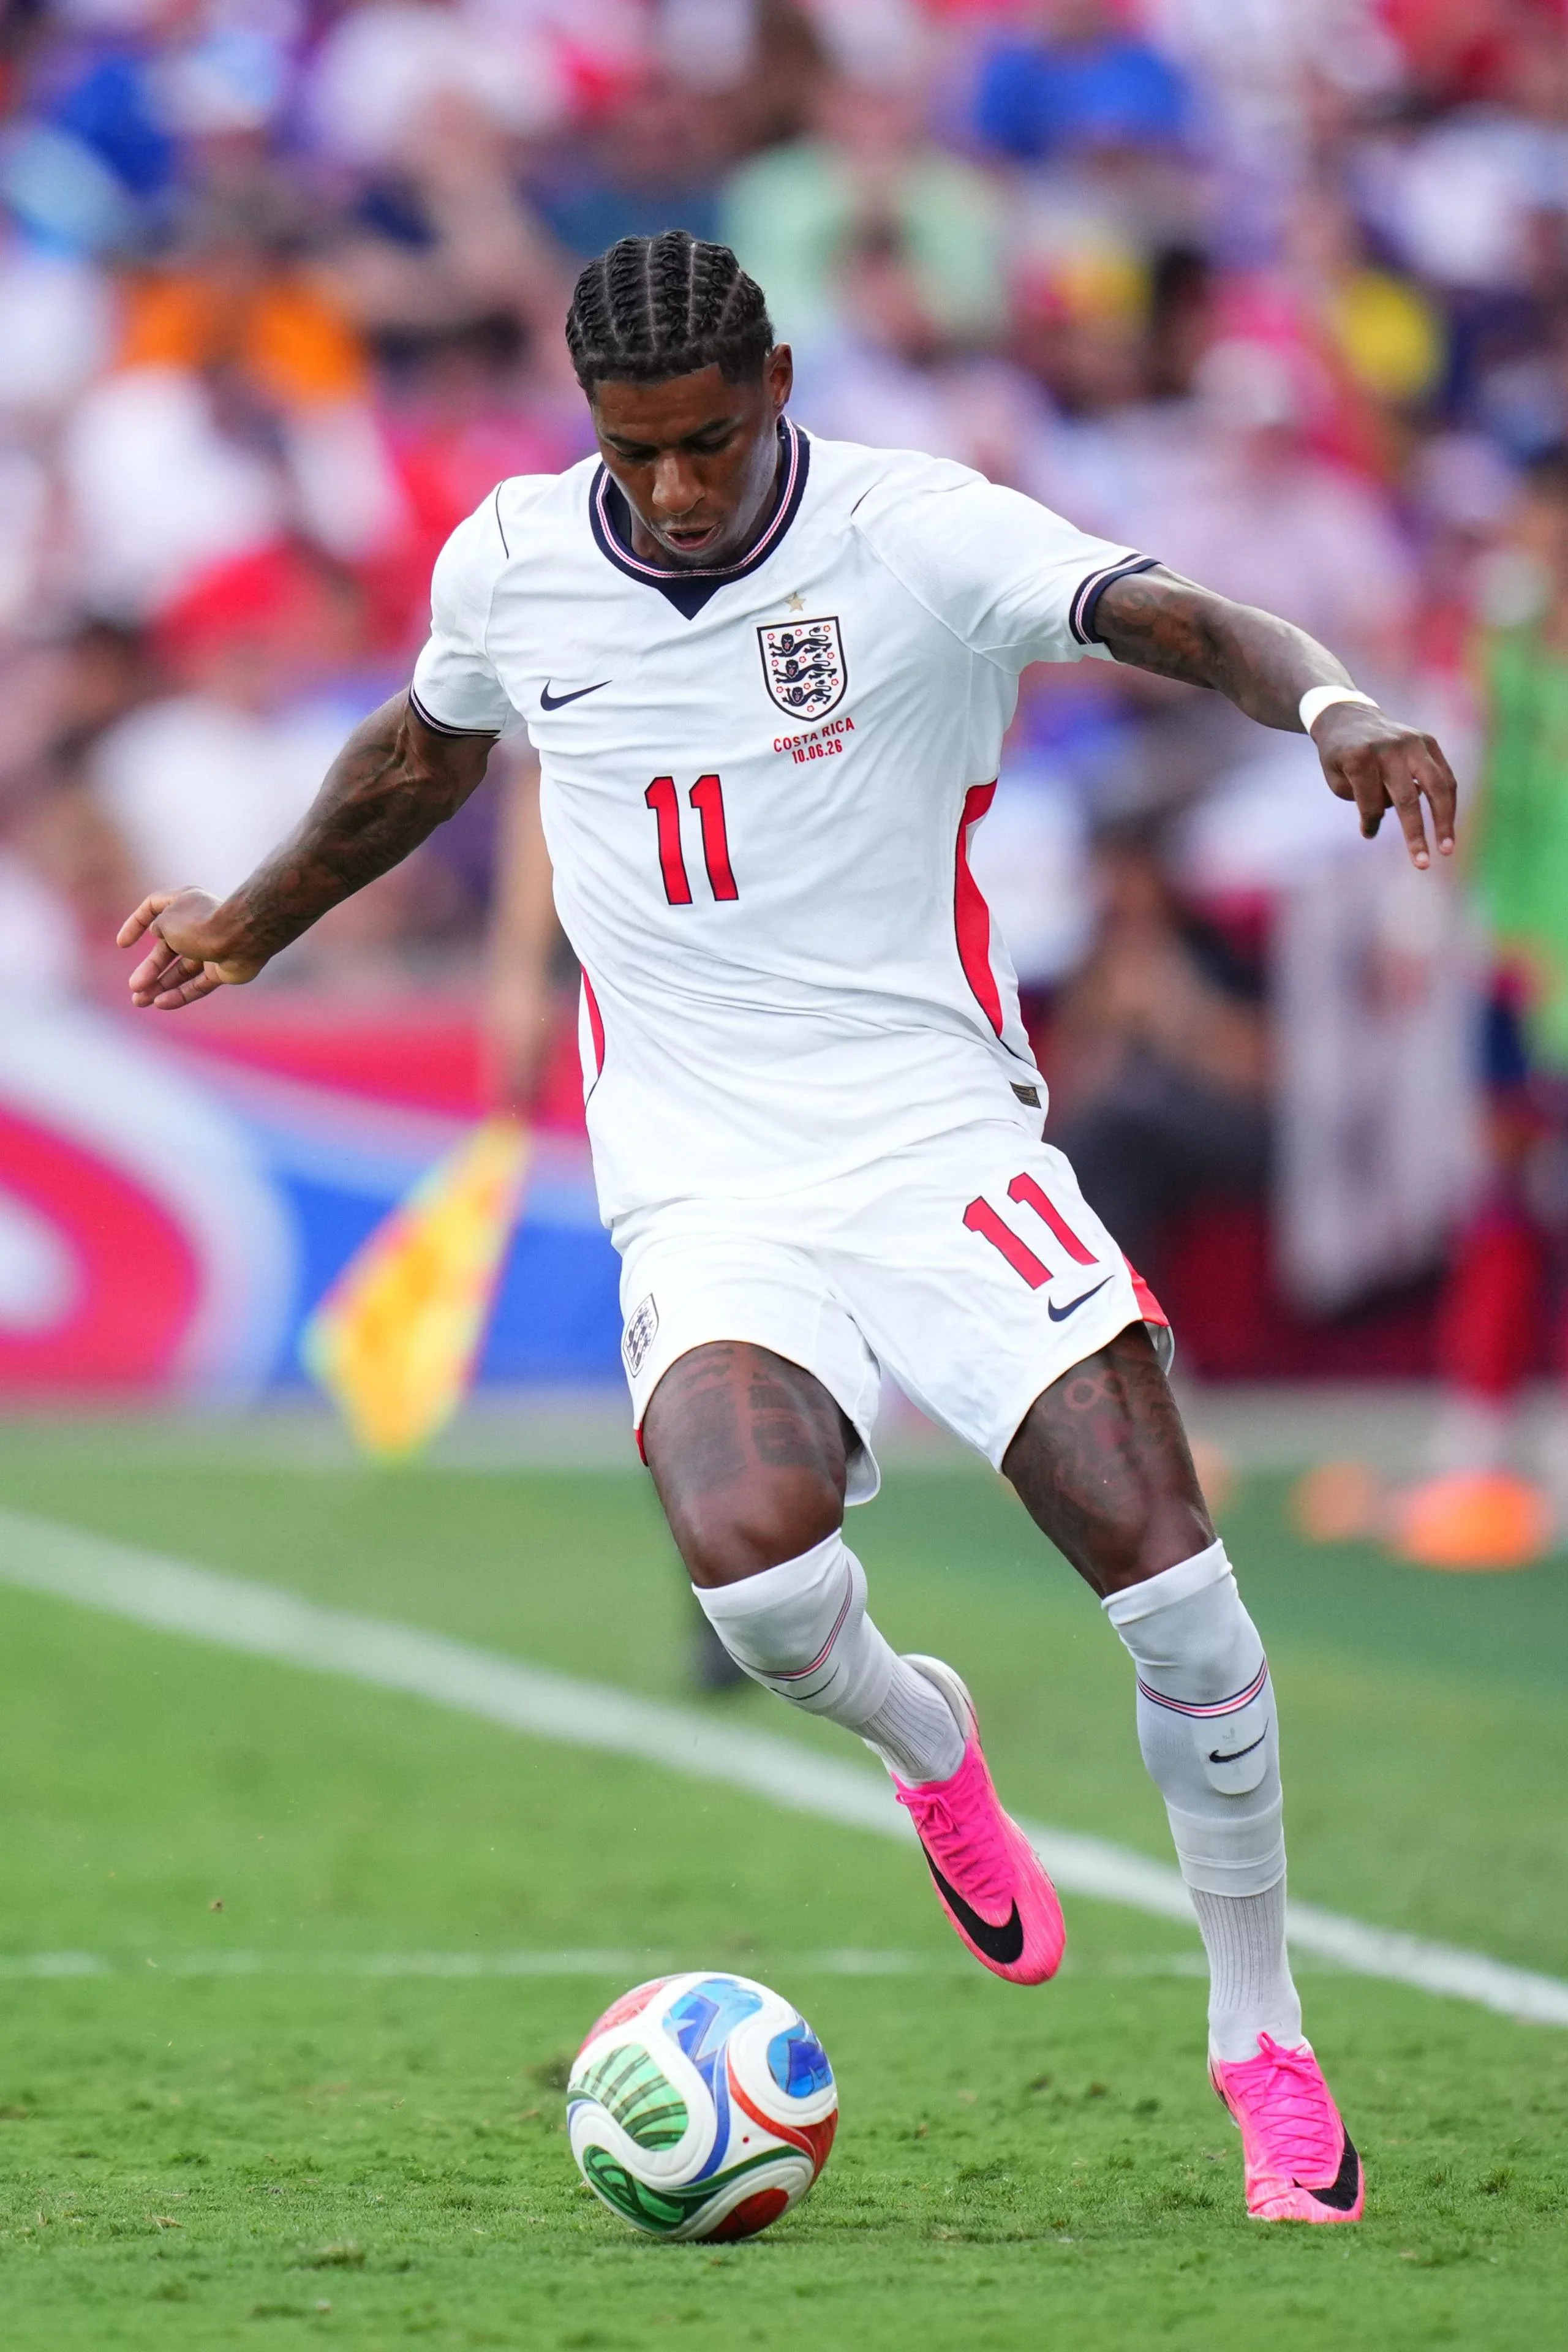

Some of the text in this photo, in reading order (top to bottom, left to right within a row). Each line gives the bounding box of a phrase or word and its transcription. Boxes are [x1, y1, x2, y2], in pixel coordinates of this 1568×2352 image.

[774, 717, 854, 753] COSTA RICA
[791, 739, 843, 764] 10.06.26
[644, 774, 739, 905] 11
[962, 1172, 1100, 1290] 11
